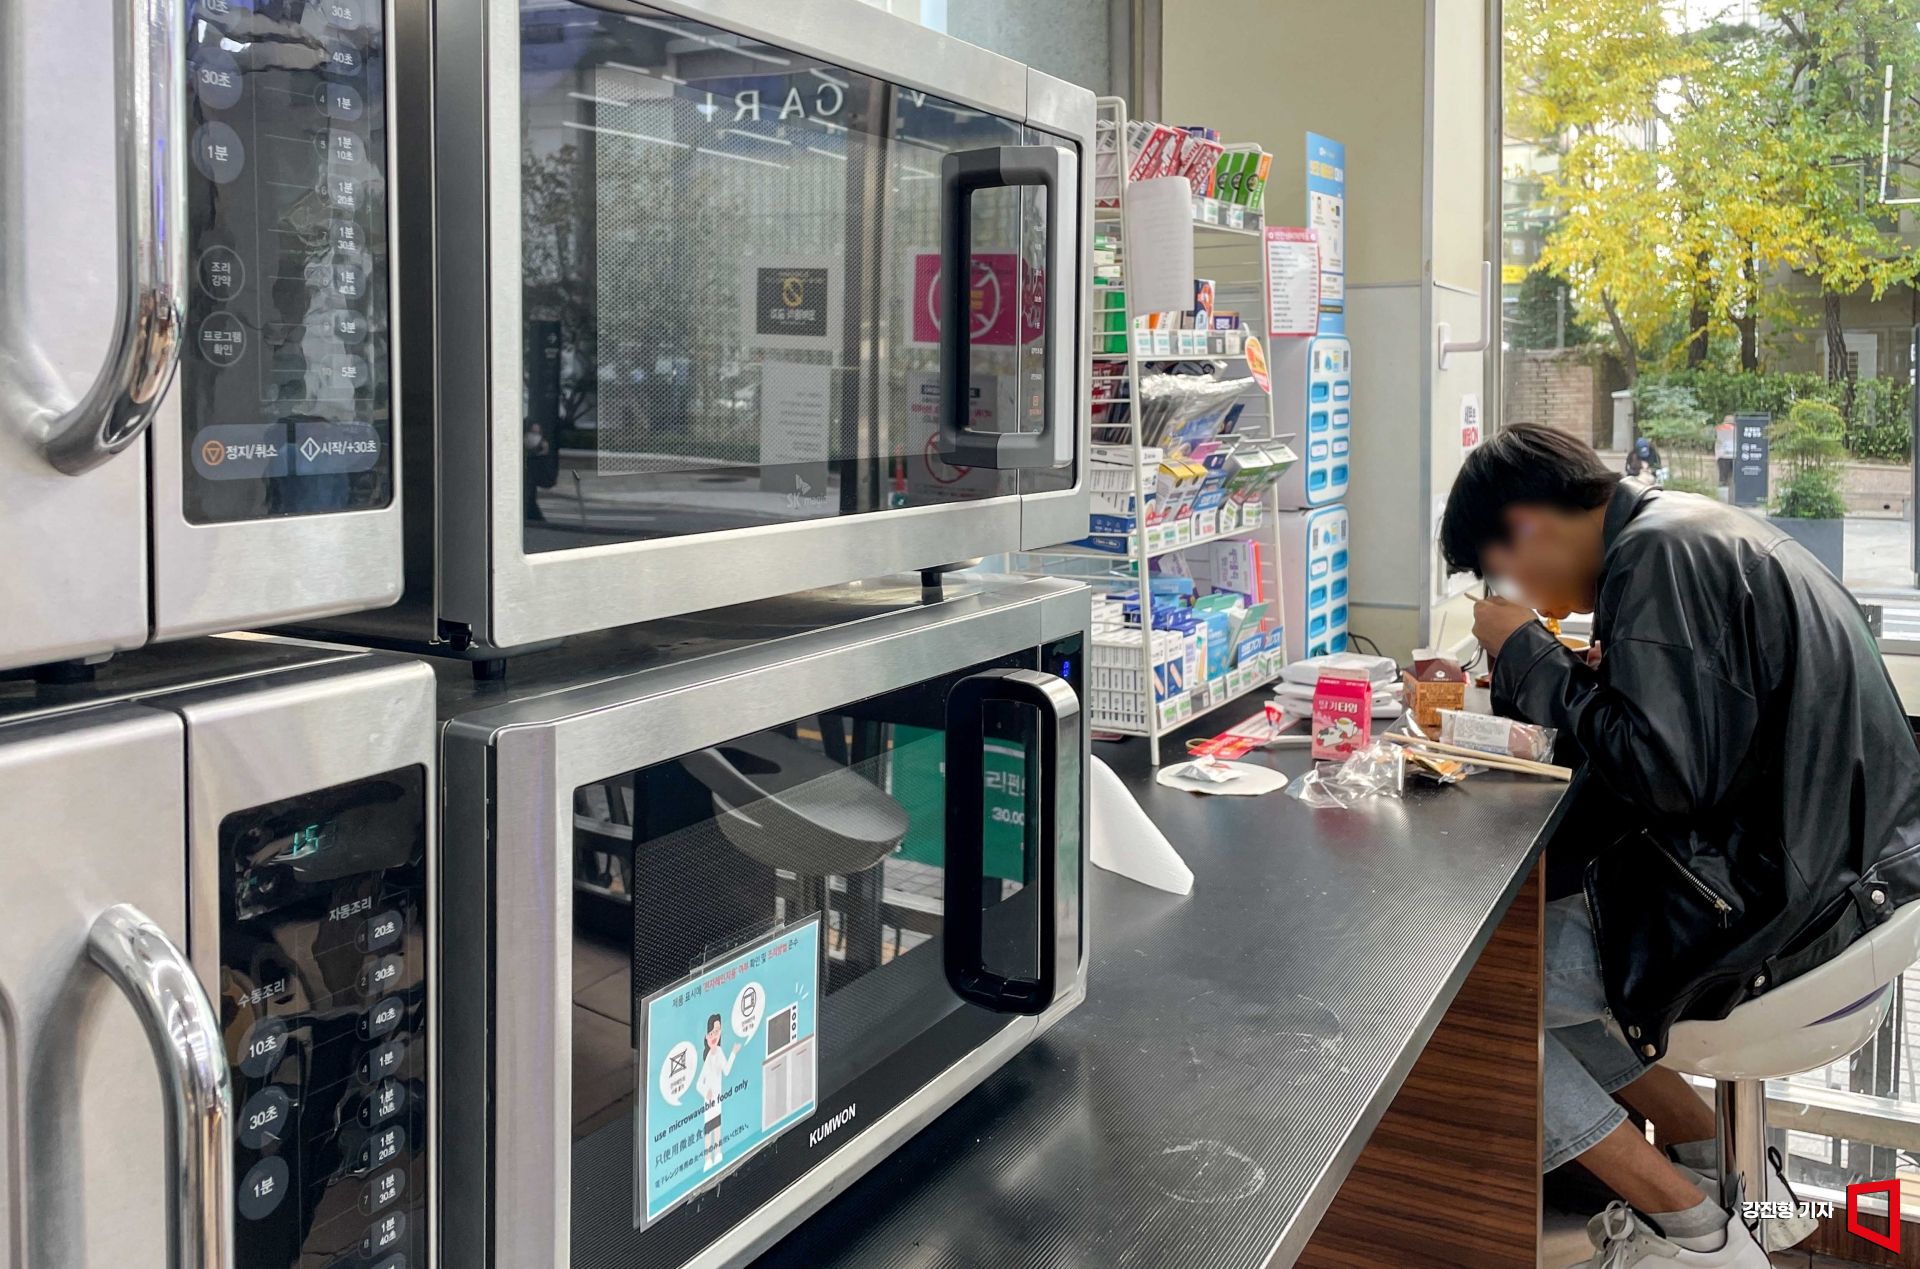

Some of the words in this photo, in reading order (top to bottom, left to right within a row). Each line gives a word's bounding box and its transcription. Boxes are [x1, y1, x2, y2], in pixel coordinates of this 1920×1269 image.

[331, 5, 352, 20] 30초
[332, 52, 353, 65] 40초
[201, 70, 231, 88] 30초
[336, 97, 351, 110] 1분
[207, 145, 228, 162] 1분
[211, 262, 230, 273] 조리
[211, 274, 231, 287] 강약
[340, 321, 356, 334] 3분
[203, 331, 242, 343] 프로그램
[213, 344, 233, 356] 확인
[341, 366, 357, 378] 5분
[225, 446, 278, 461] 정지/취소
[321, 440, 377, 455] 시작/+30초
[329, 896, 372, 922] 자동조리
[374, 921, 396, 938] 20초
[375, 966, 396, 982] 30초
[237, 978, 285, 1008] 수동조리
[375, 1007, 396, 1024] 40초
[362, 1021, 367, 1030] 3
[250, 1036, 277, 1058] 10초
[379, 1051, 394, 1067] 1분
[380, 1089, 394, 1105] 1분
[250, 1106, 278, 1130] 30초
[378, 1103, 395, 1117] 10초
[654, 1129, 667, 1143] use
[668, 1099, 715, 1134] microwavable
[716, 1086, 733, 1104] food
[734, 1079, 749, 1093] only
[810, 1103, 856, 1148] KUMWON
[380, 1131, 395, 1147] 1분
[378, 1145, 396, 1161] 20초
[253, 1177, 275, 1198] 1분
[380, 1175, 395, 1191] 1분
[379, 1189, 396, 1204] 30초
[381, 1217, 395, 1233] 1분
[379, 1231, 397, 1247] 40초
